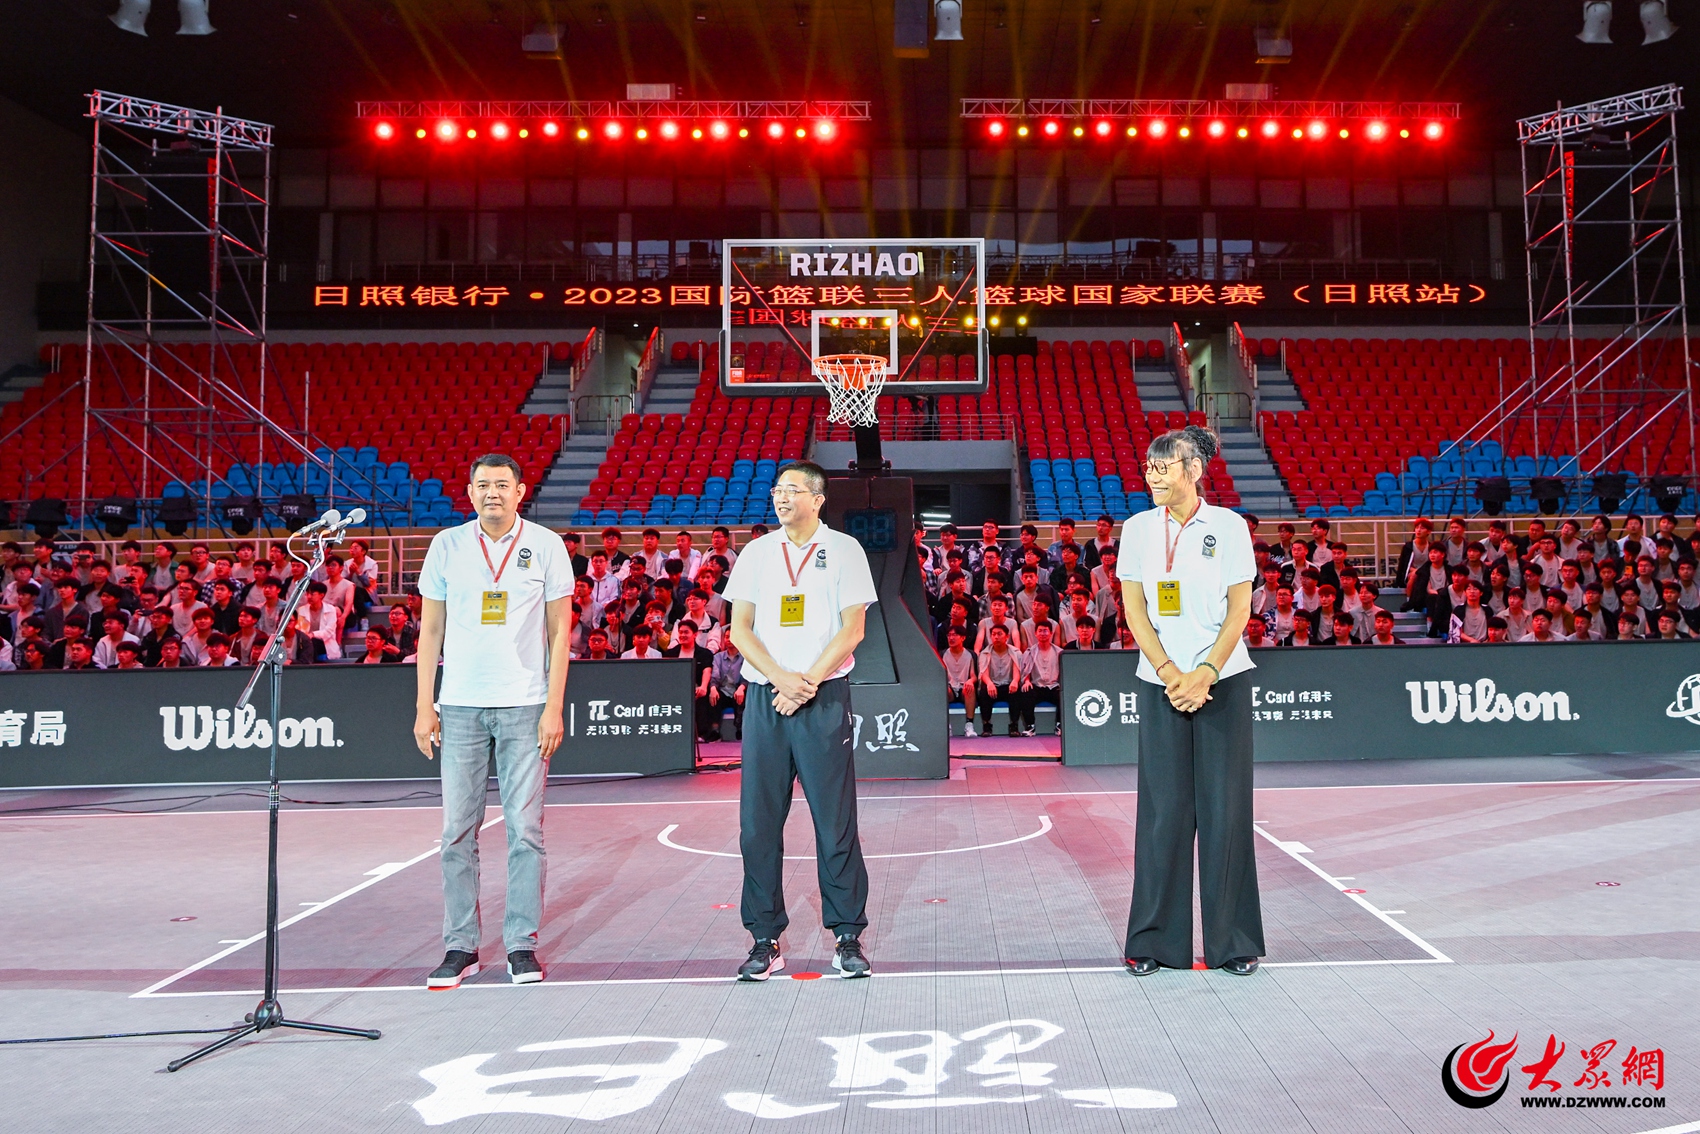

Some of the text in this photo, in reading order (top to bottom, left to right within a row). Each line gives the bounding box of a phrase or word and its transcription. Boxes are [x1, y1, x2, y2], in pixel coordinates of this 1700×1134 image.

[790, 252, 919, 276] RIZHAO
[1265, 690, 1295, 704] Card
[613, 704, 645, 718] Card
[410, 1019, 1178, 1124] 日照
